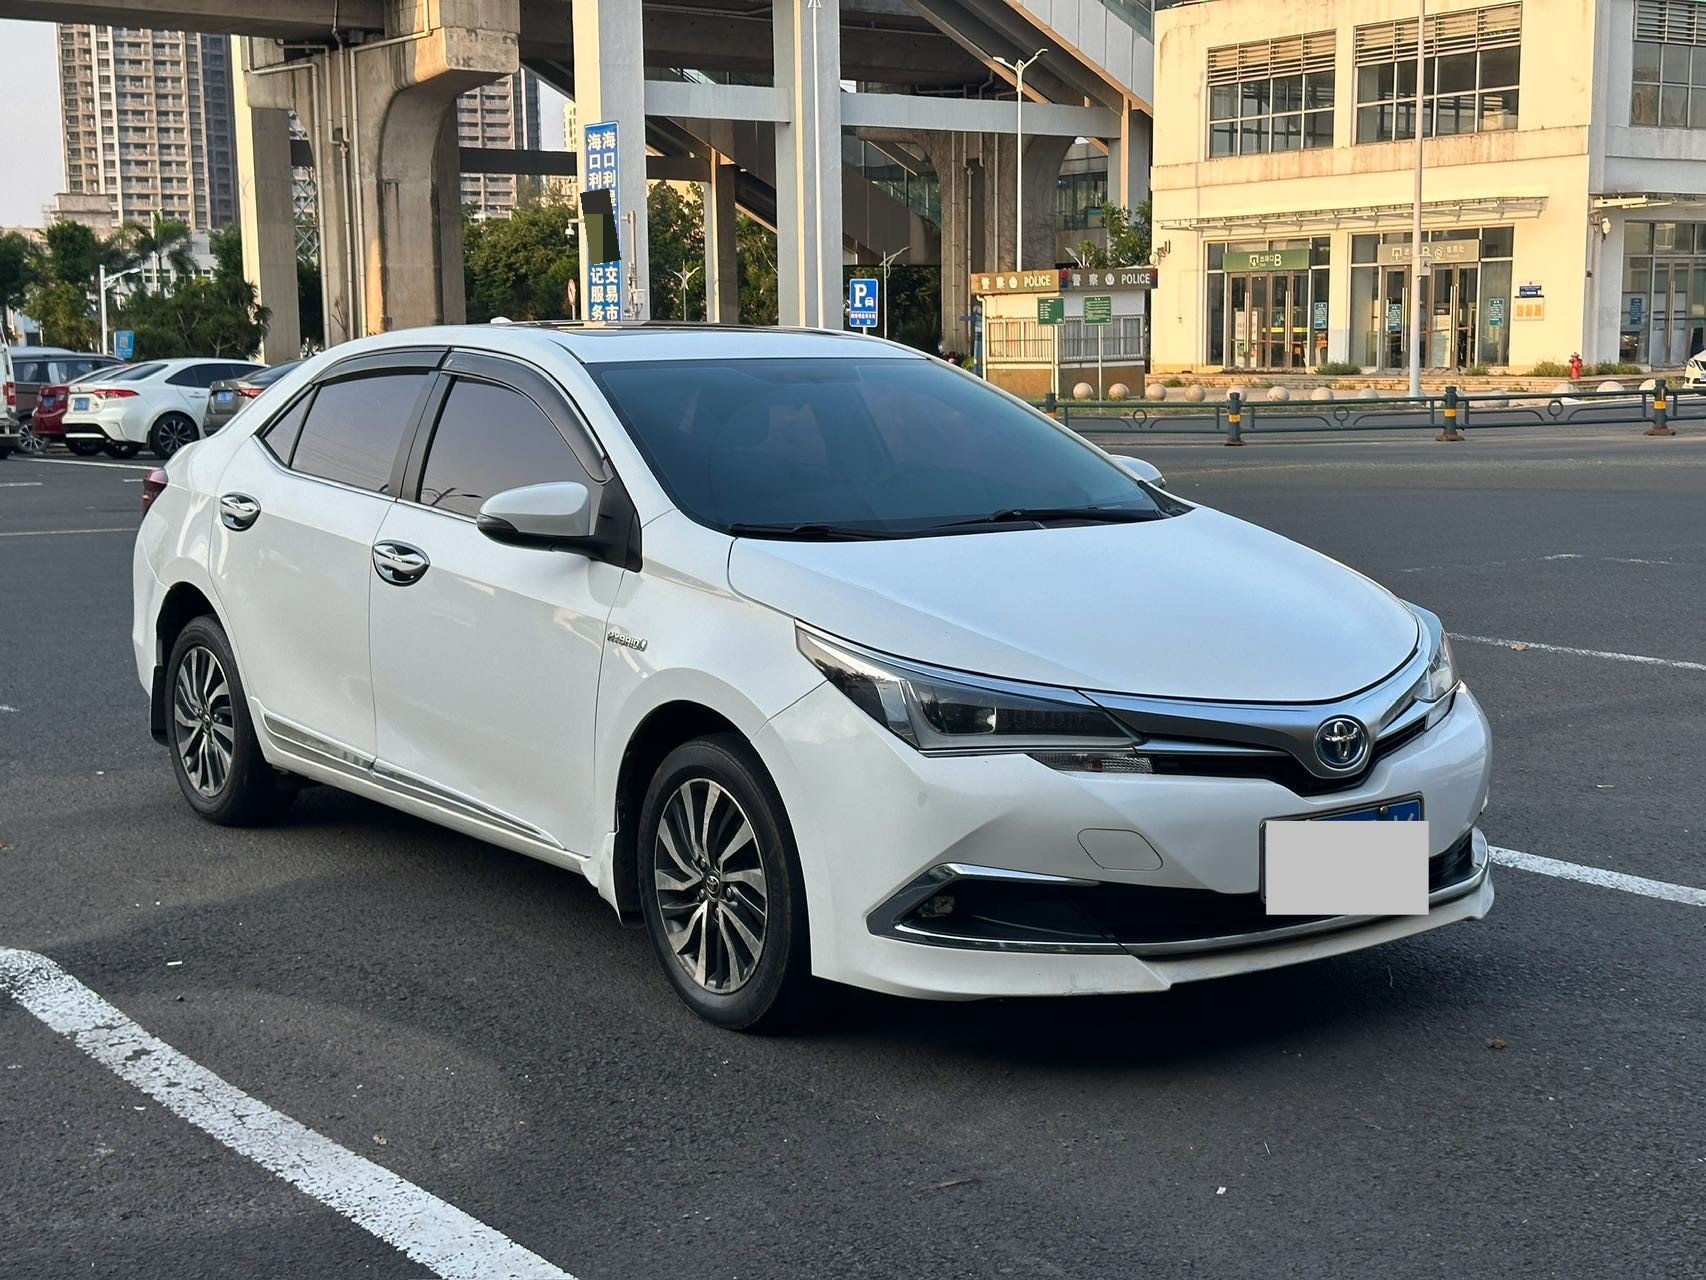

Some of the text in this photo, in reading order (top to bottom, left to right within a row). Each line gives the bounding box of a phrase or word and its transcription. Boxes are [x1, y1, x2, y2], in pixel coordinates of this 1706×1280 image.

[1274, 253, 1282, 267] B
[1024, 275, 1051, 288] POLICE
[1121, 273, 1151, 285] POLICE
[853, 283, 867, 307] P
